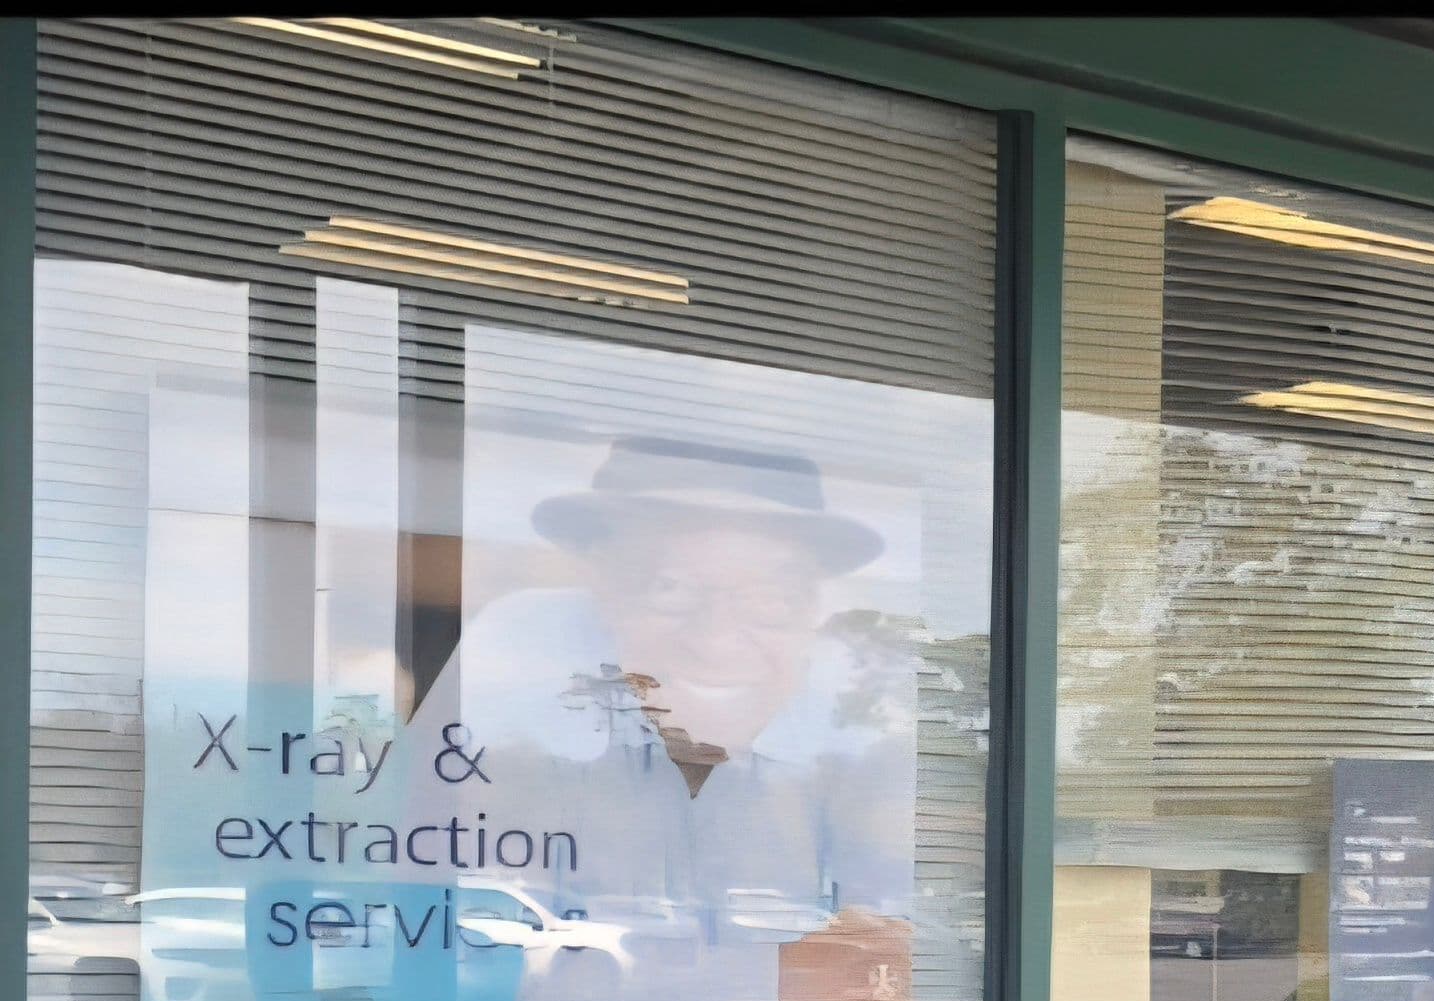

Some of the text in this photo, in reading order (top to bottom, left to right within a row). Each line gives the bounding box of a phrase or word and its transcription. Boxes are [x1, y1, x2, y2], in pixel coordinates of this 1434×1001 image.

[193, 713, 492, 795] X-ray &
[214, 812, 578, 872] extraction
